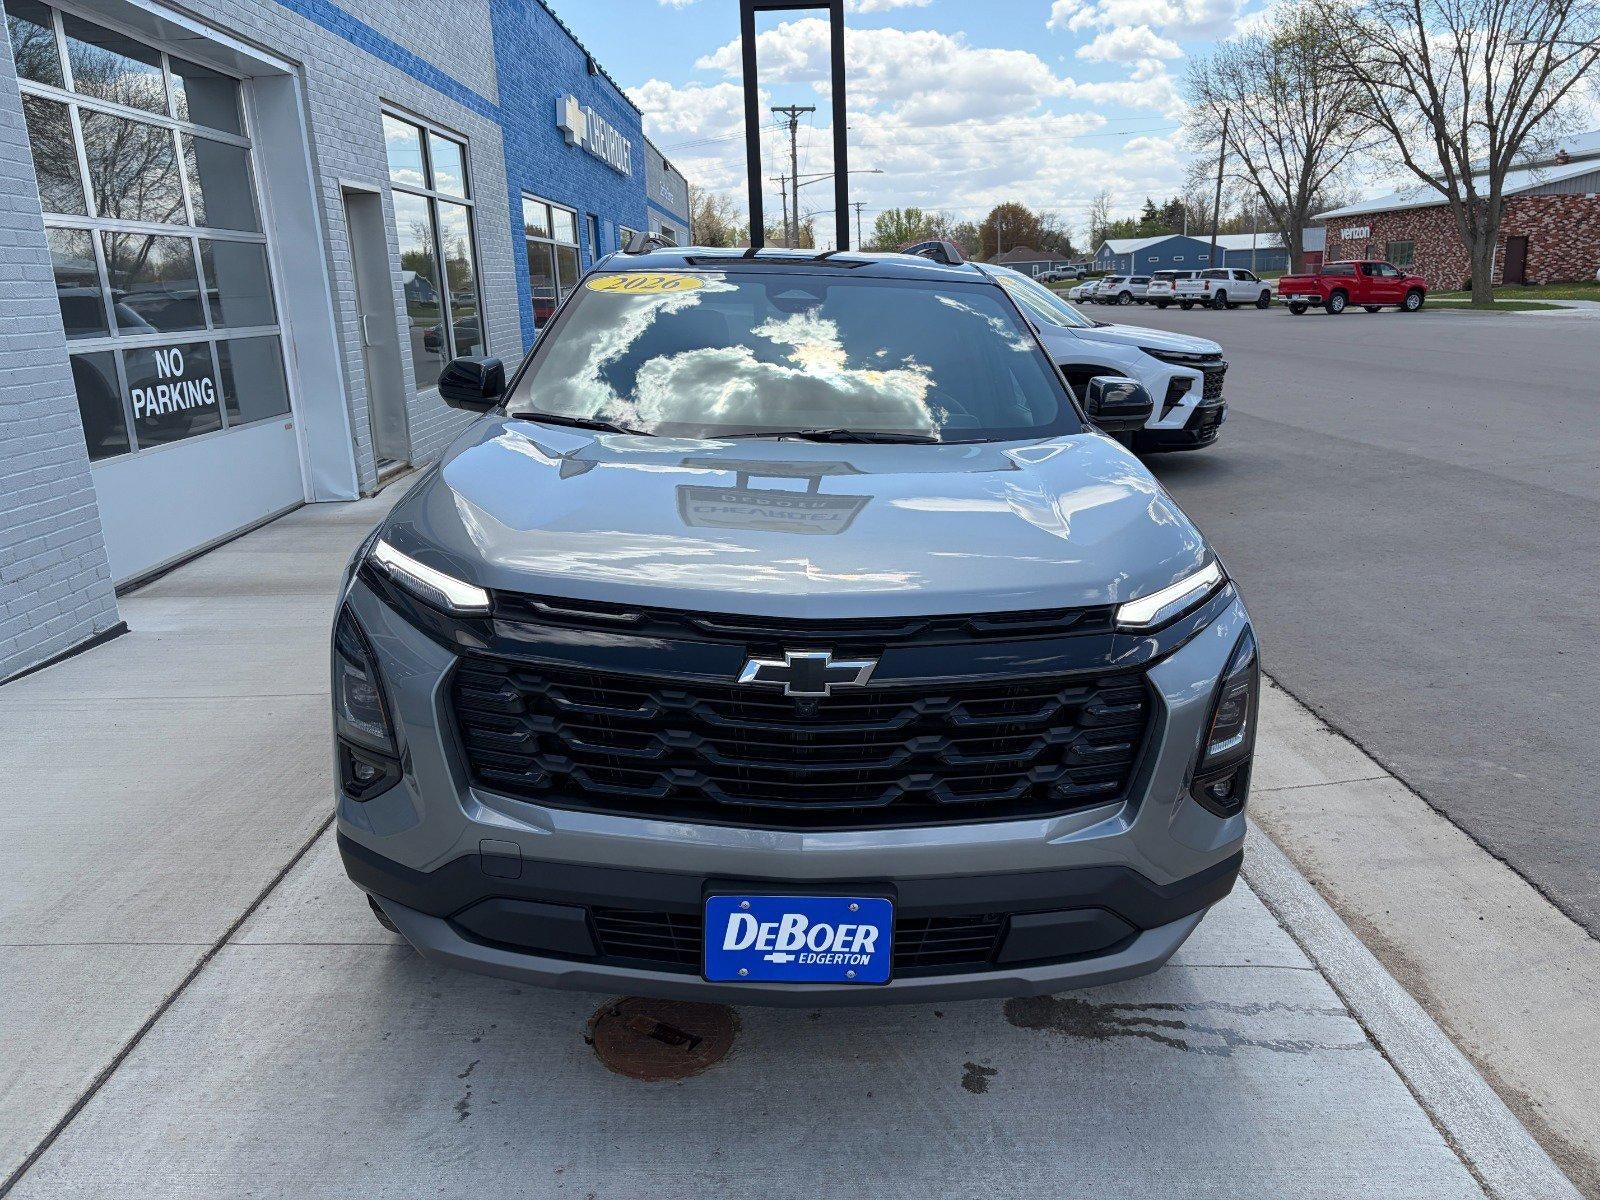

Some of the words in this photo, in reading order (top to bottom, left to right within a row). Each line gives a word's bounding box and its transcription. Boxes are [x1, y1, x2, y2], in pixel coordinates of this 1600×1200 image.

[587, 105, 632, 177] CHEVROLET
[1341, 225, 1370, 240] verizon
[603, 277, 682, 290] 2026
[155, 348, 184, 379] NO
[131, 377, 215, 419] PARKING
[799, 952, 871, 966] EDGERTON
